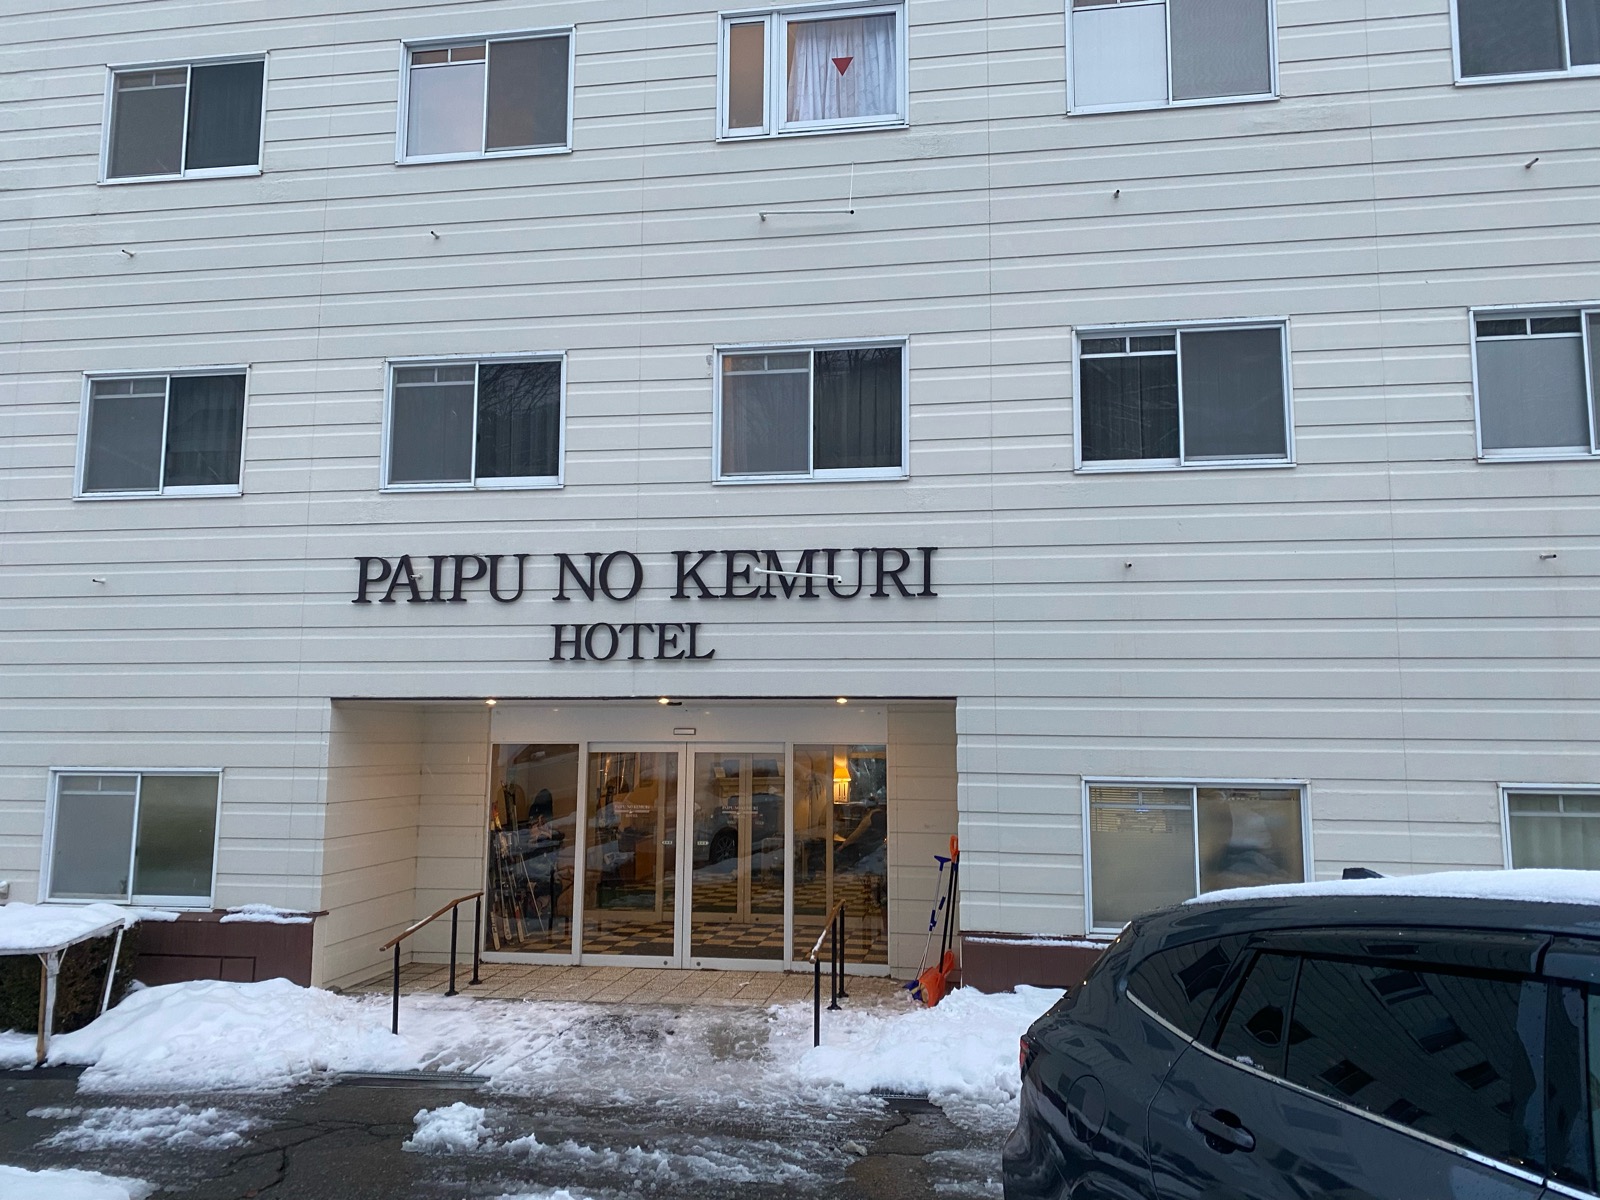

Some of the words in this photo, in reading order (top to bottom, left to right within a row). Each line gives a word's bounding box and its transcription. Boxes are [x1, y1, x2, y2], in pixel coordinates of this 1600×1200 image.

[351, 553, 530, 604] PAIPU
[552, 550, 644, 602] NO
[669, 546, 939, 601] KEMURI
[548, 622, 716, 662] HOTEL
